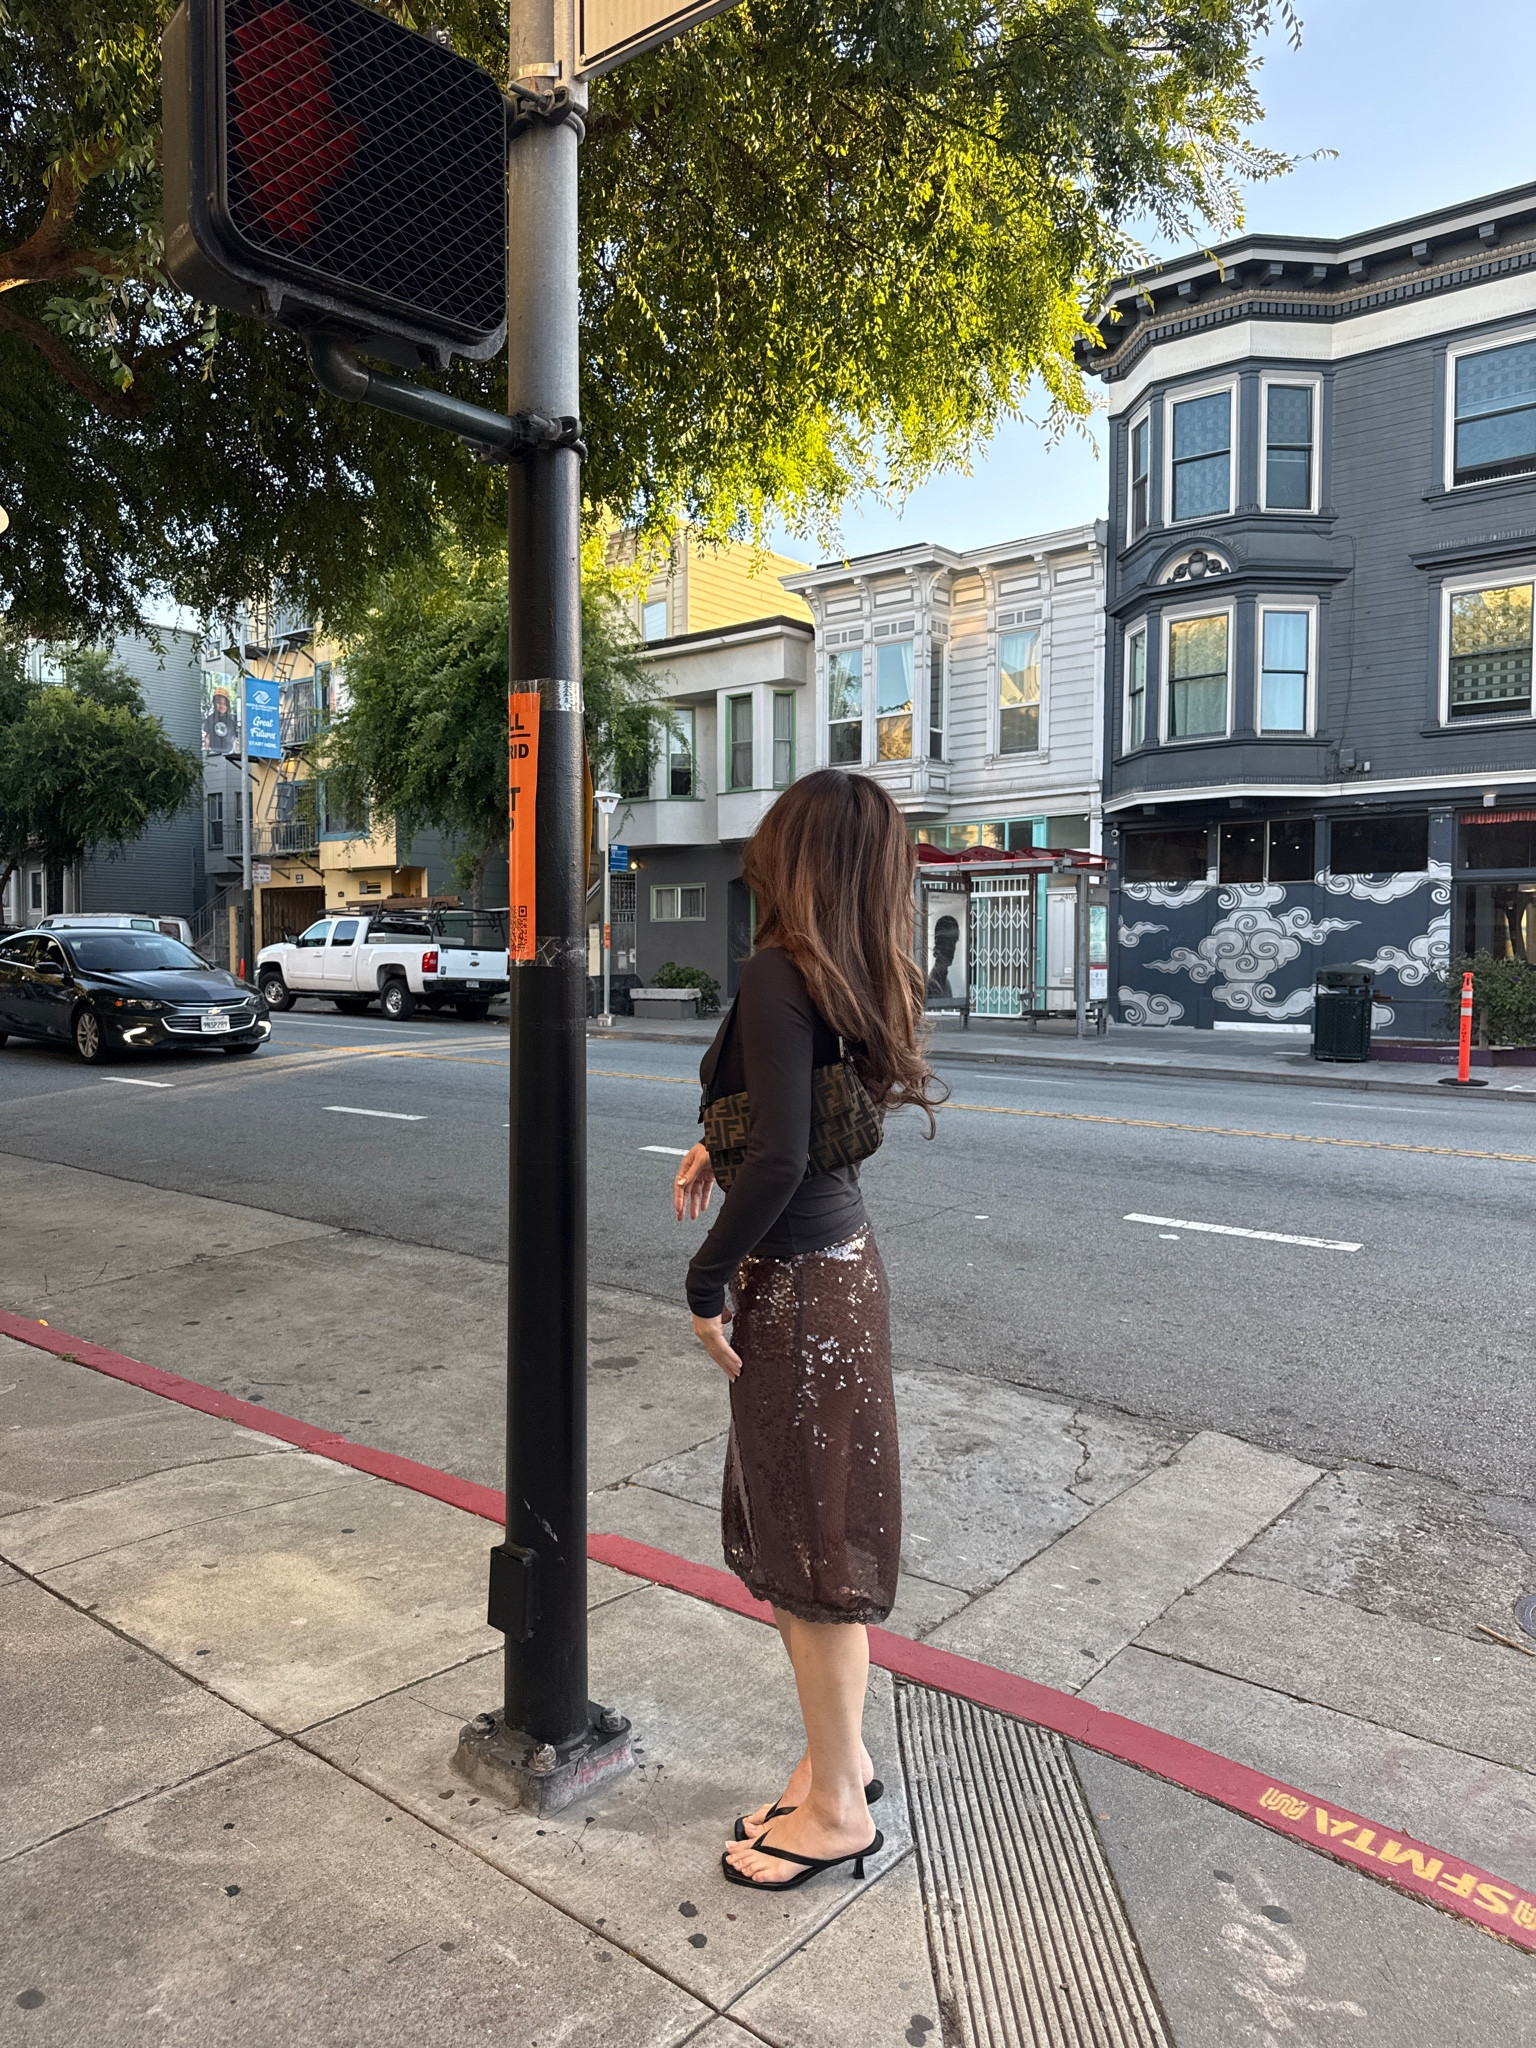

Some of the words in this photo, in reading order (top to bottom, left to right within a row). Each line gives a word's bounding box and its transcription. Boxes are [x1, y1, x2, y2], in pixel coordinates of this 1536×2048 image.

[253, 716, 273, 727] Great
[250, 727, 276, 739] Futures
[1315, 1807, 1516, 1915] SFMTA
